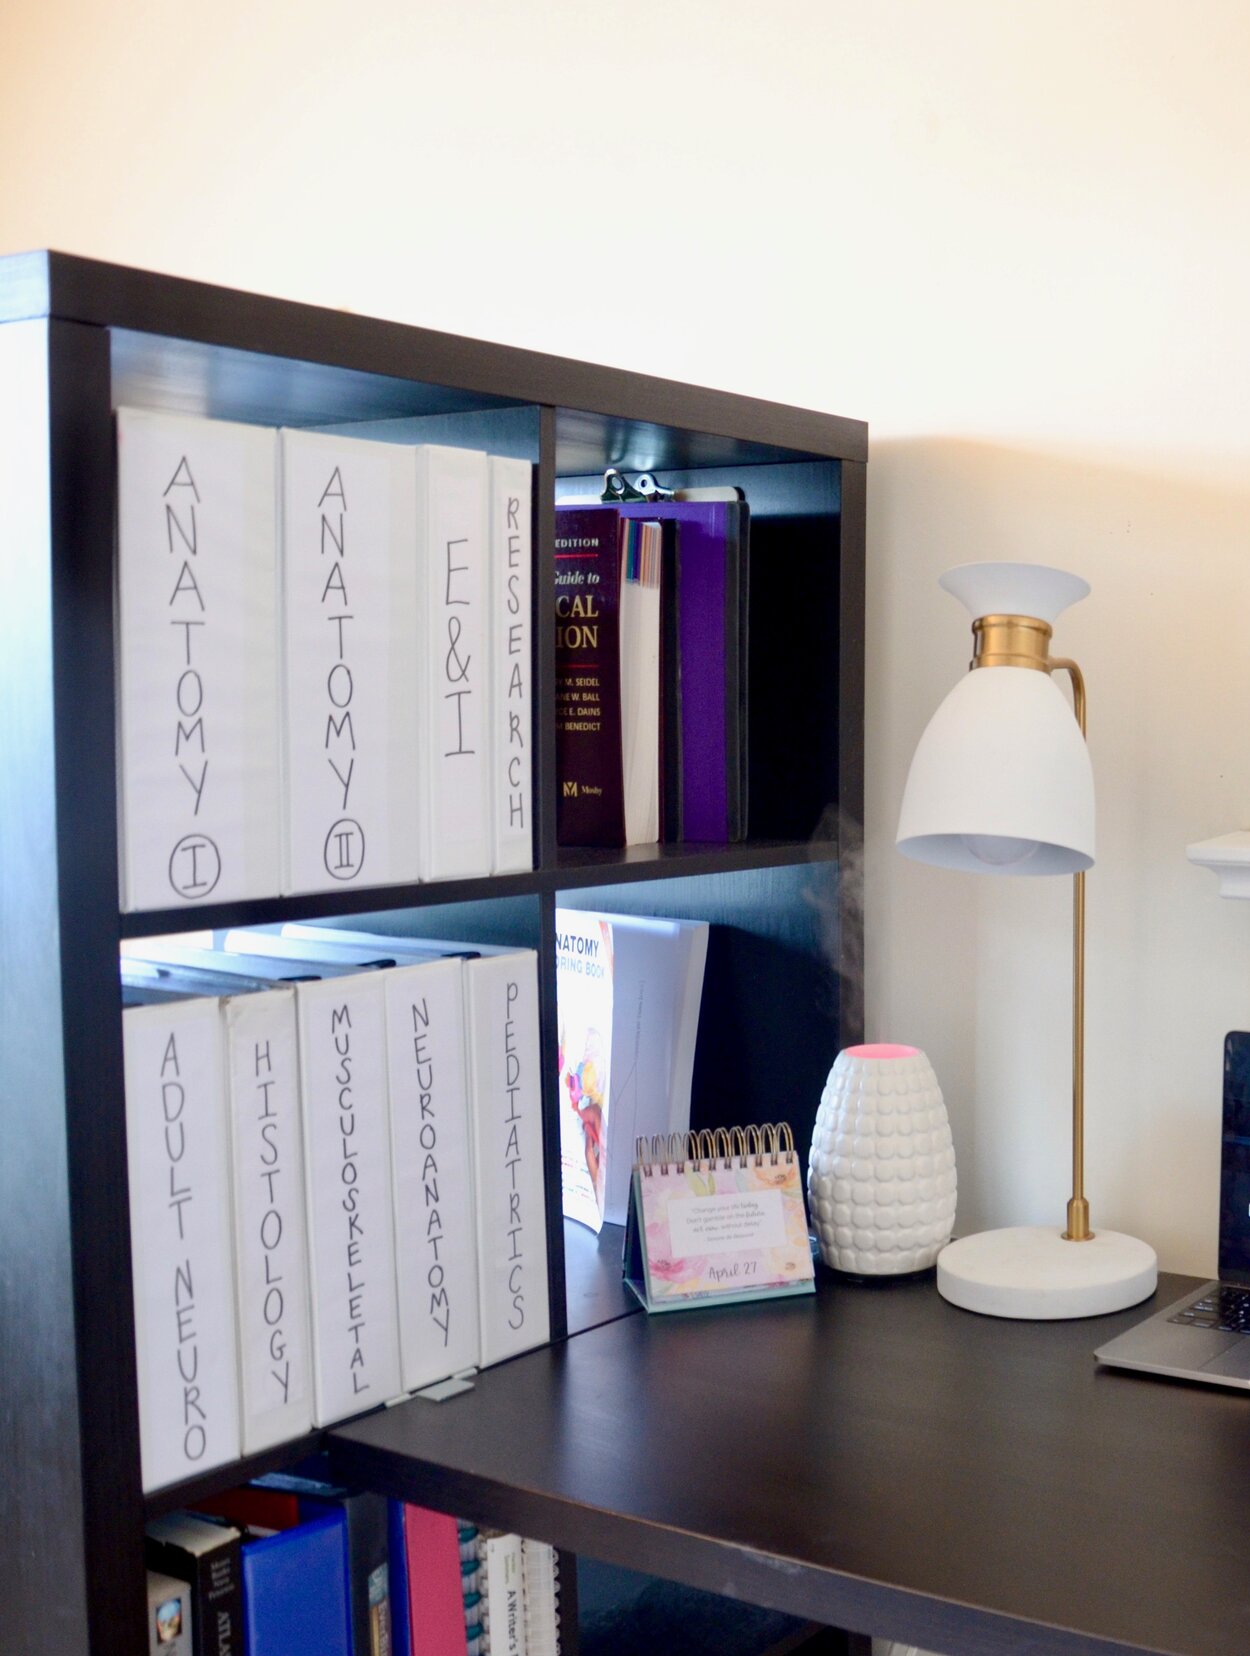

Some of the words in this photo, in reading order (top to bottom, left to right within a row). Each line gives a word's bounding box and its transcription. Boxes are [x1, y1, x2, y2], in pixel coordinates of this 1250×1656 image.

[554, 538, 599, 549] EDITION
[587, 571, 600, 585] to
[555, 594, 599, 618] CAL
[163, 455, 208, 816] ANATOMY
[317, 466, 356, 811] ANATOMY
[506, 496, 525, 829] RESEARCH
[575, 678, 600, 687] SEIDEL
[582, 693, 600, 701] BALL
[565, 722, 601, 731] BENEDICT
[577, 707, 601, 716] DAINS
[555, 932, 599, 958] NATOMY
[160, 1031, 194, 1240] ADULT
[411, 997, 450, 1348] NEUROANATOMY
[504, 981, 525, 1331] PEDIATRICS
[331, 1003, 370, 1395] MUSCULOSKELETAL
[254, 1039, 290, 1404] HISTOLOGY
[708, 1262, 739, 1283] April
[744, 1261, 757, 1275] 27
[173, 1259, 206, 1461] NEURO
[507, 1590, 516, 1601] A
[507, 1602, 518, 1650] Writer's
